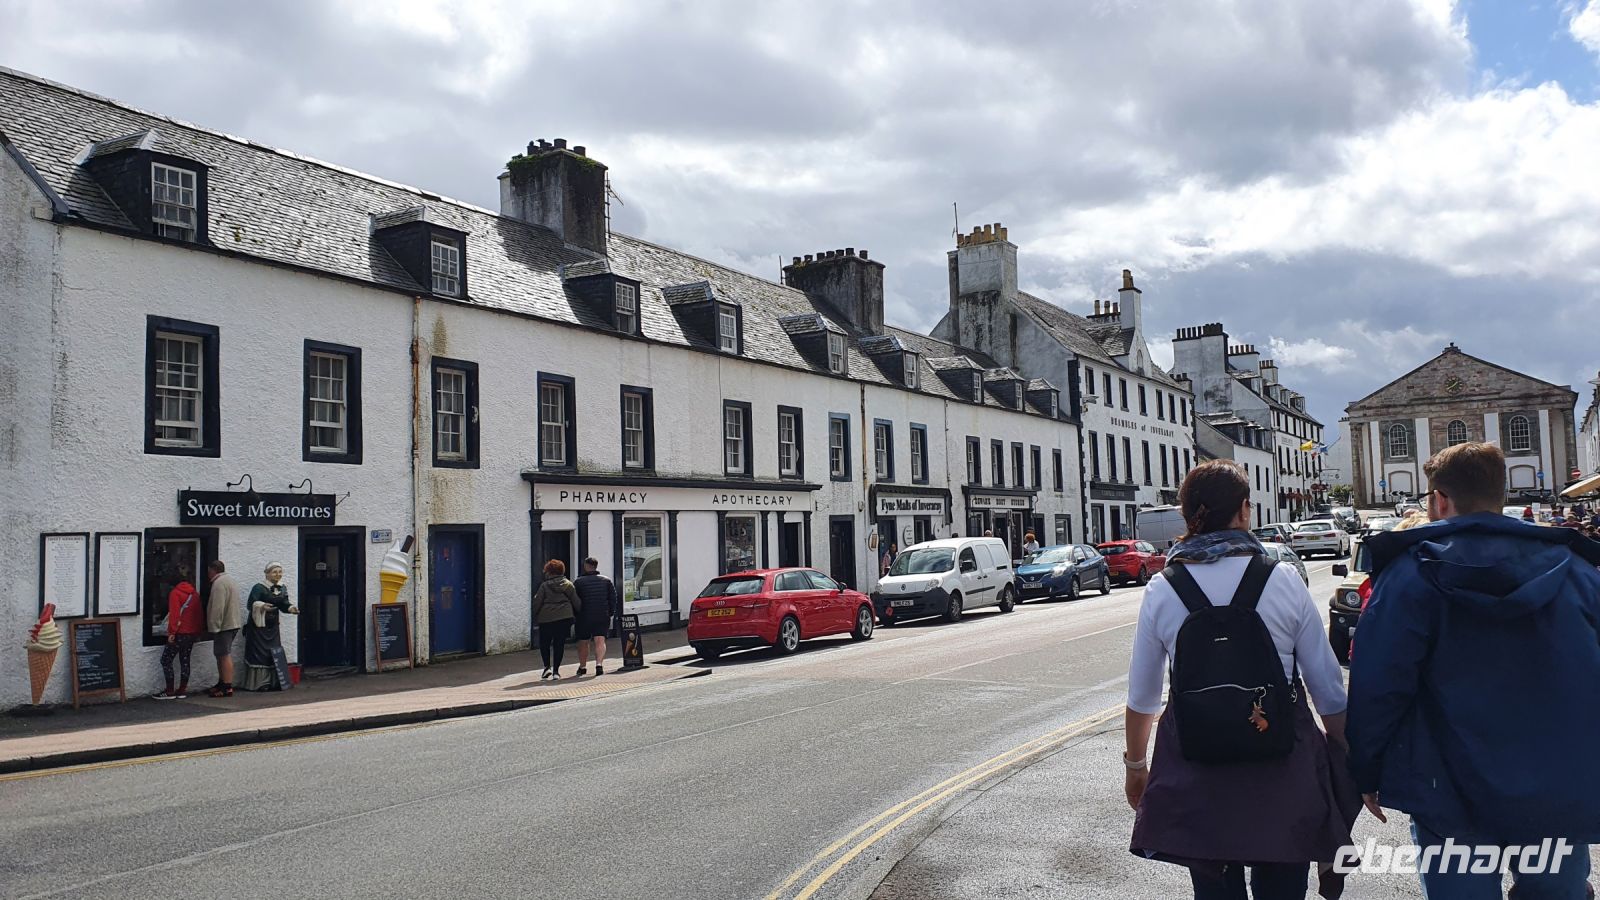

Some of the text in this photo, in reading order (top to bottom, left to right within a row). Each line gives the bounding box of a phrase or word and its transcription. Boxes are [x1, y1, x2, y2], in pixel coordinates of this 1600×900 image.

[1141, 424, 1146, 432] of
[560, 490, 793, 506] PHARMACY APOTHECARY
[187, 499, 331, 518] Sweet Memories
[881, 499, 895, 514] Fyne
[912, 499, 918, 511] of
[918, 499, 942, 514] Inveraray
[622, 621, 636, 629] FARM
